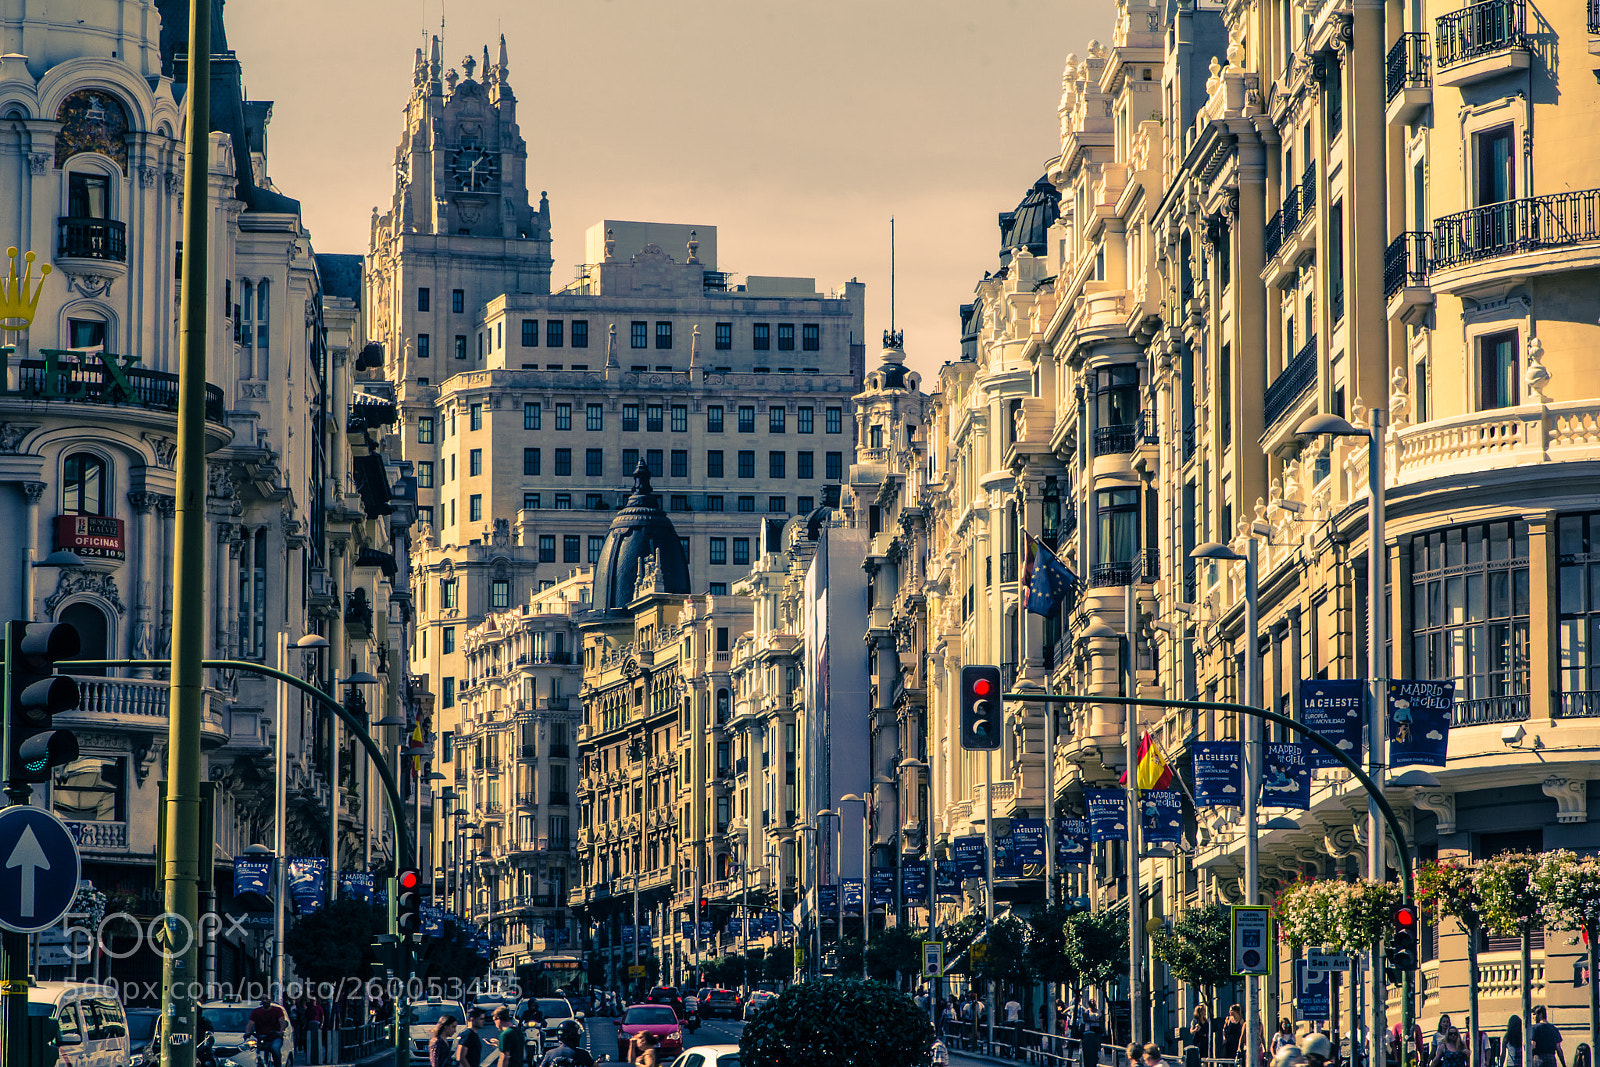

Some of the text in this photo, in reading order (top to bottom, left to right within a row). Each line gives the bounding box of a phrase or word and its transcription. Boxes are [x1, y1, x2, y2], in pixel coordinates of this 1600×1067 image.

[76, 537, 119, 548] OFICINAS
[1400, 683, 1443, 696] MADRID
[1305, 698, 1359, 708] LA CELESTE
[1420, 696, 1450, 709] CIELO
[1269, 745, 1302, 755] MADRID
